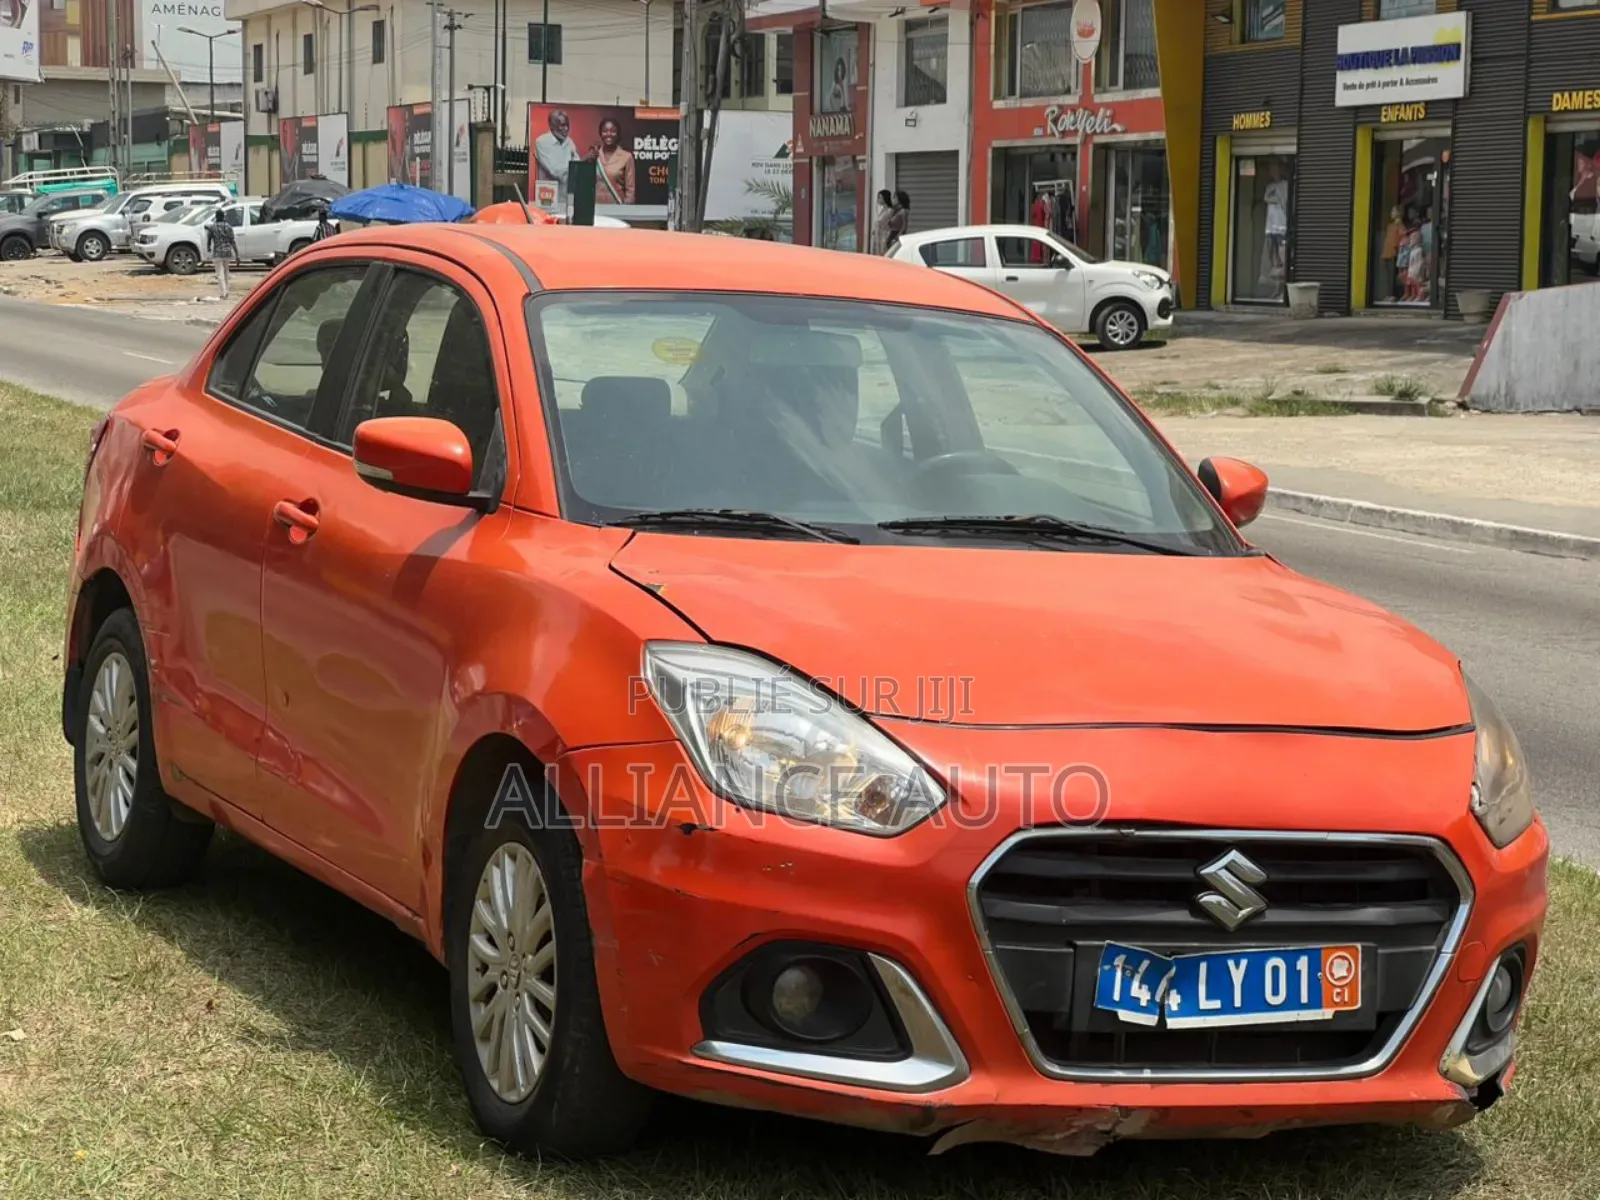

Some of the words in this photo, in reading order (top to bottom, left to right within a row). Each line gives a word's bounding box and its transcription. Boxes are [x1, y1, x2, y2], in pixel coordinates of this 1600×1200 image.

[151, 2, 221, 17] AMÉNAG
[1343, 82, 1357, 91] Vente
[1552, 90, 1600, 112] DAMES
[1232, 110, 1271, 131] HOMMES
[1380, 102, 1426, 123] ENFANTS
[633, 151, 653, 160] TON
[649, 165, 669, 176] CH
[1197, 957, 1249, 1010] LY
[1263, 954, 1310, 1006] 01
